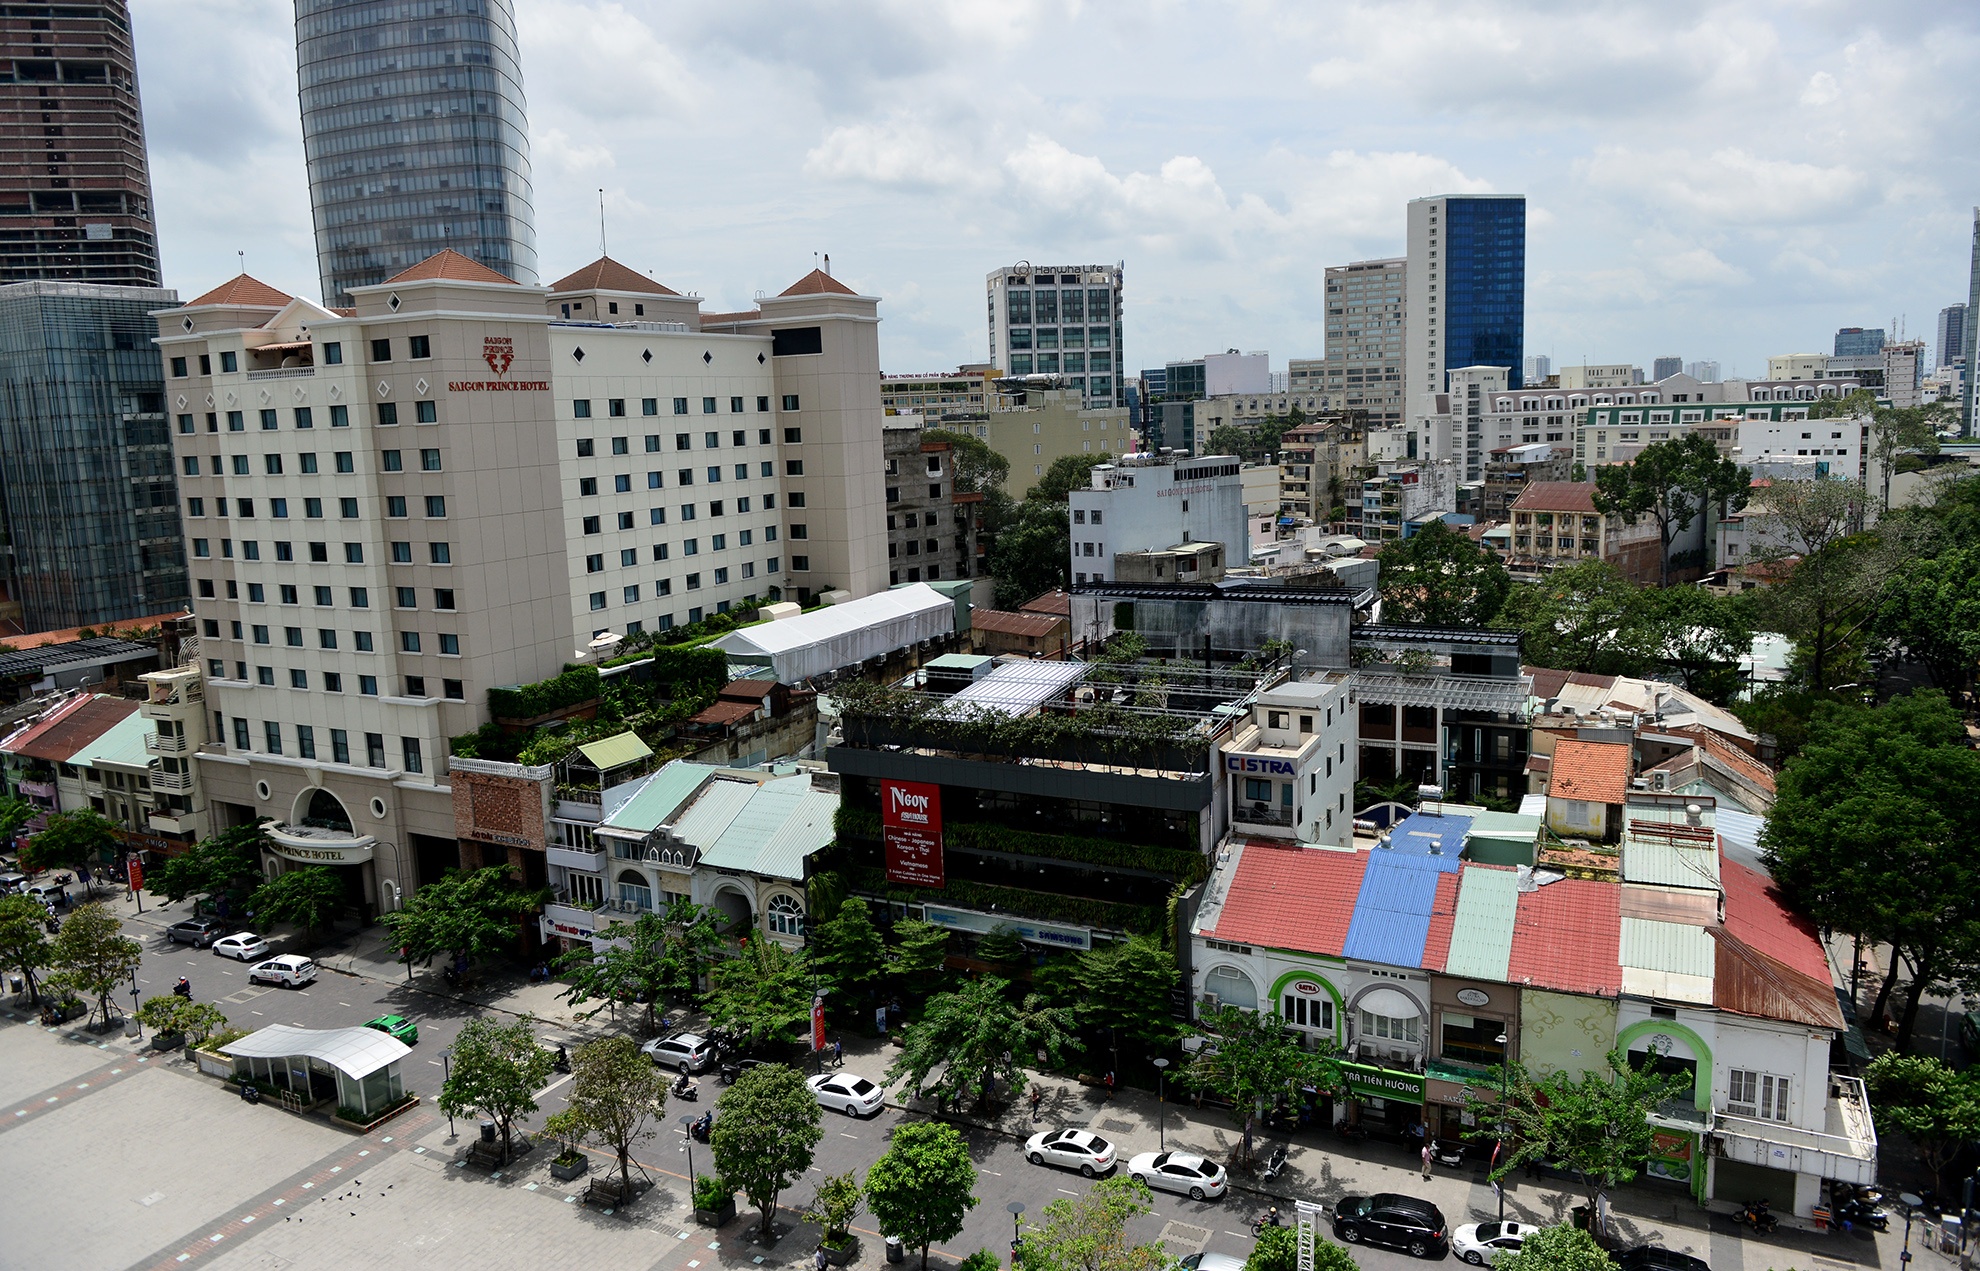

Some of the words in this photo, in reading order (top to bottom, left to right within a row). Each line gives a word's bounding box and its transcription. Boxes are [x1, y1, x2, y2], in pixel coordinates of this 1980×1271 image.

[1035, 265, 1081, 274] Hanwha
[1083, 264, 1103, 273] Life
[484, 337, 512, 345] SAIGON
[448, 381, 484, 392] SAIGON
[486, 381, 519, 391] PRINCE
[520, 381, 549, 391] HOTEL
[1228, 757, 1296, 776] CISTRA
[146, 838, 168, 848] AMIGO
[912, 838, 935, 846] Japanese
[284, 847, 311, 858] PRINCE
[312, 851, 344, 860] HOTEL
[900, 860, 929, 869] Vietnamese
[1038, 931, 1084, 945] SAMSUNG
[1298, 984, 1316, 992] SATRA
[1344, 1071, 1361, 1082] TRÀ
